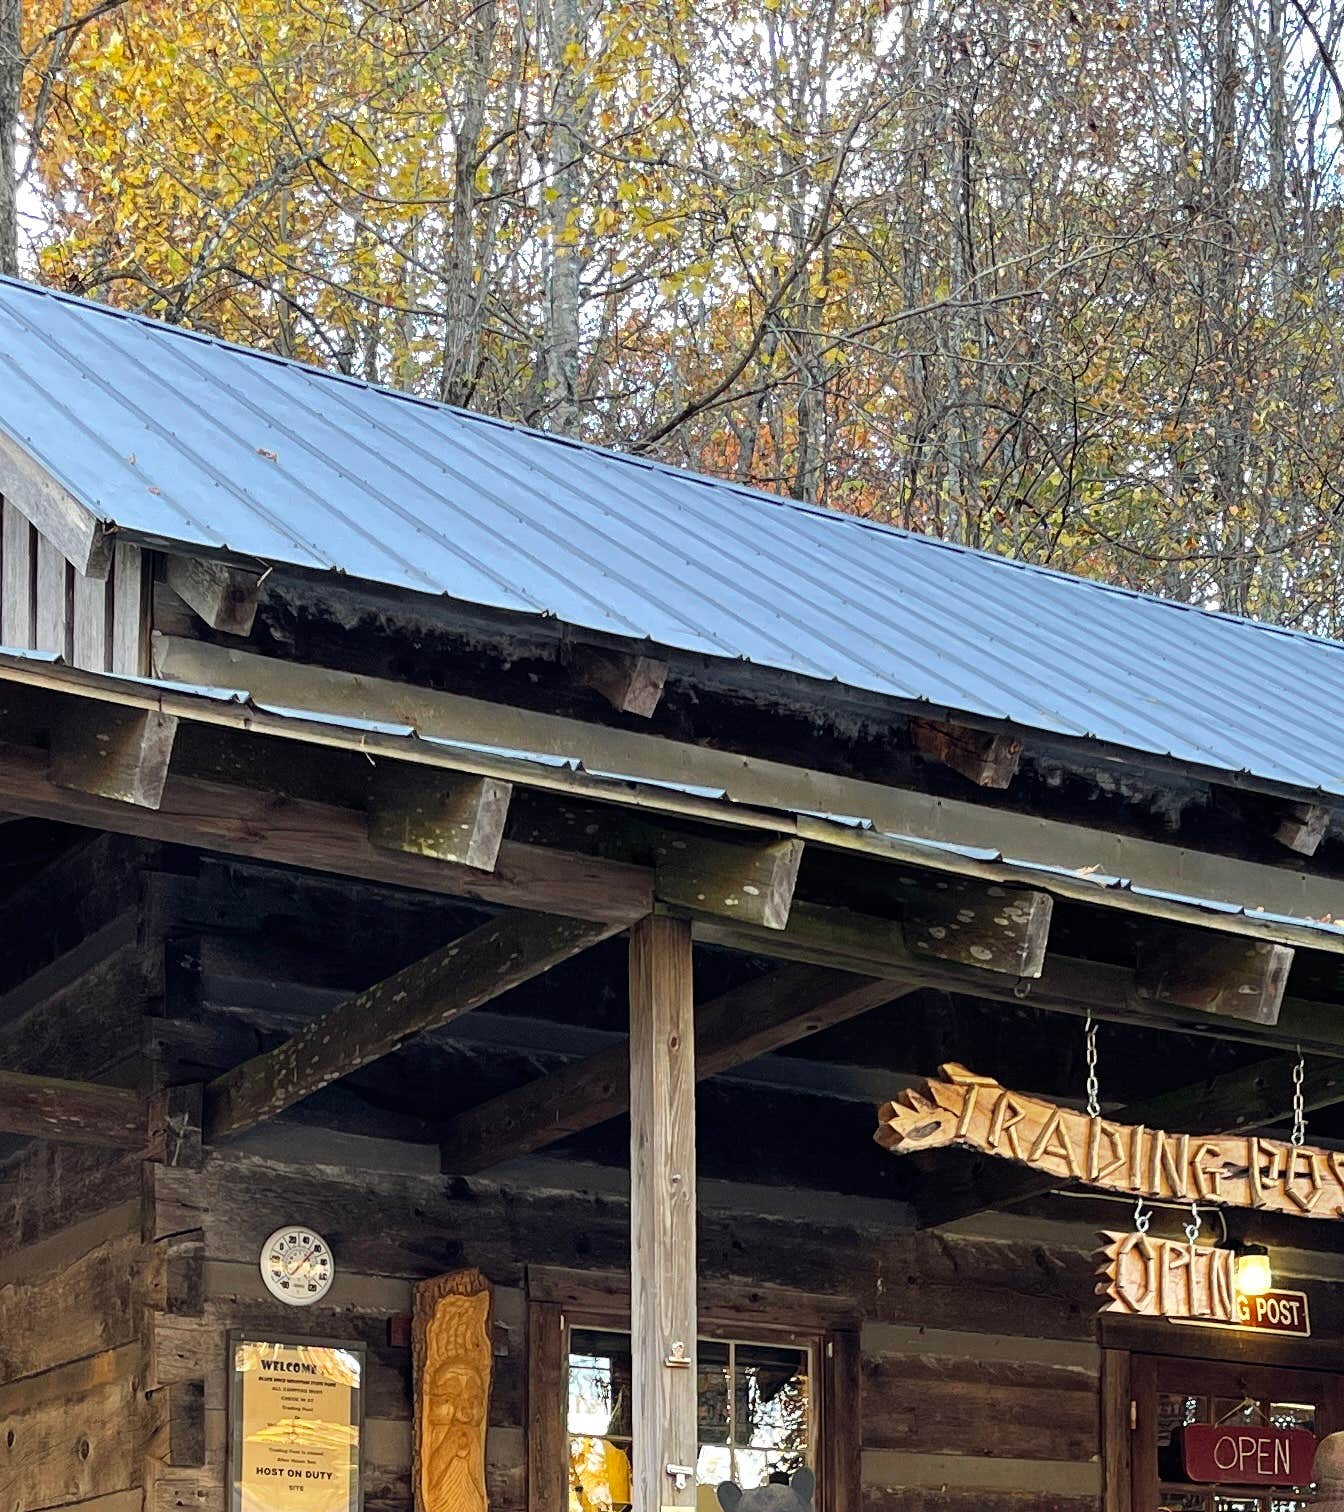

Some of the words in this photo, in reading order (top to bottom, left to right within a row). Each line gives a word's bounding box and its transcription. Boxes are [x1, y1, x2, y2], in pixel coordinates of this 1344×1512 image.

[953, 1075, 1227, 1205] TRADING
[1117, 1232, 1235, 1320] OPEN
[1256, 1297, 1300, 1326] POST
[261, 1360, 317, 1374] WELCOME
[1214, 1436, 1291, 1475] OPEN
[256, 1467, 284, 1477] HOST
[288, 1469, 302, 1478] ON
[306, 1471, 333, 1480] DUTY
